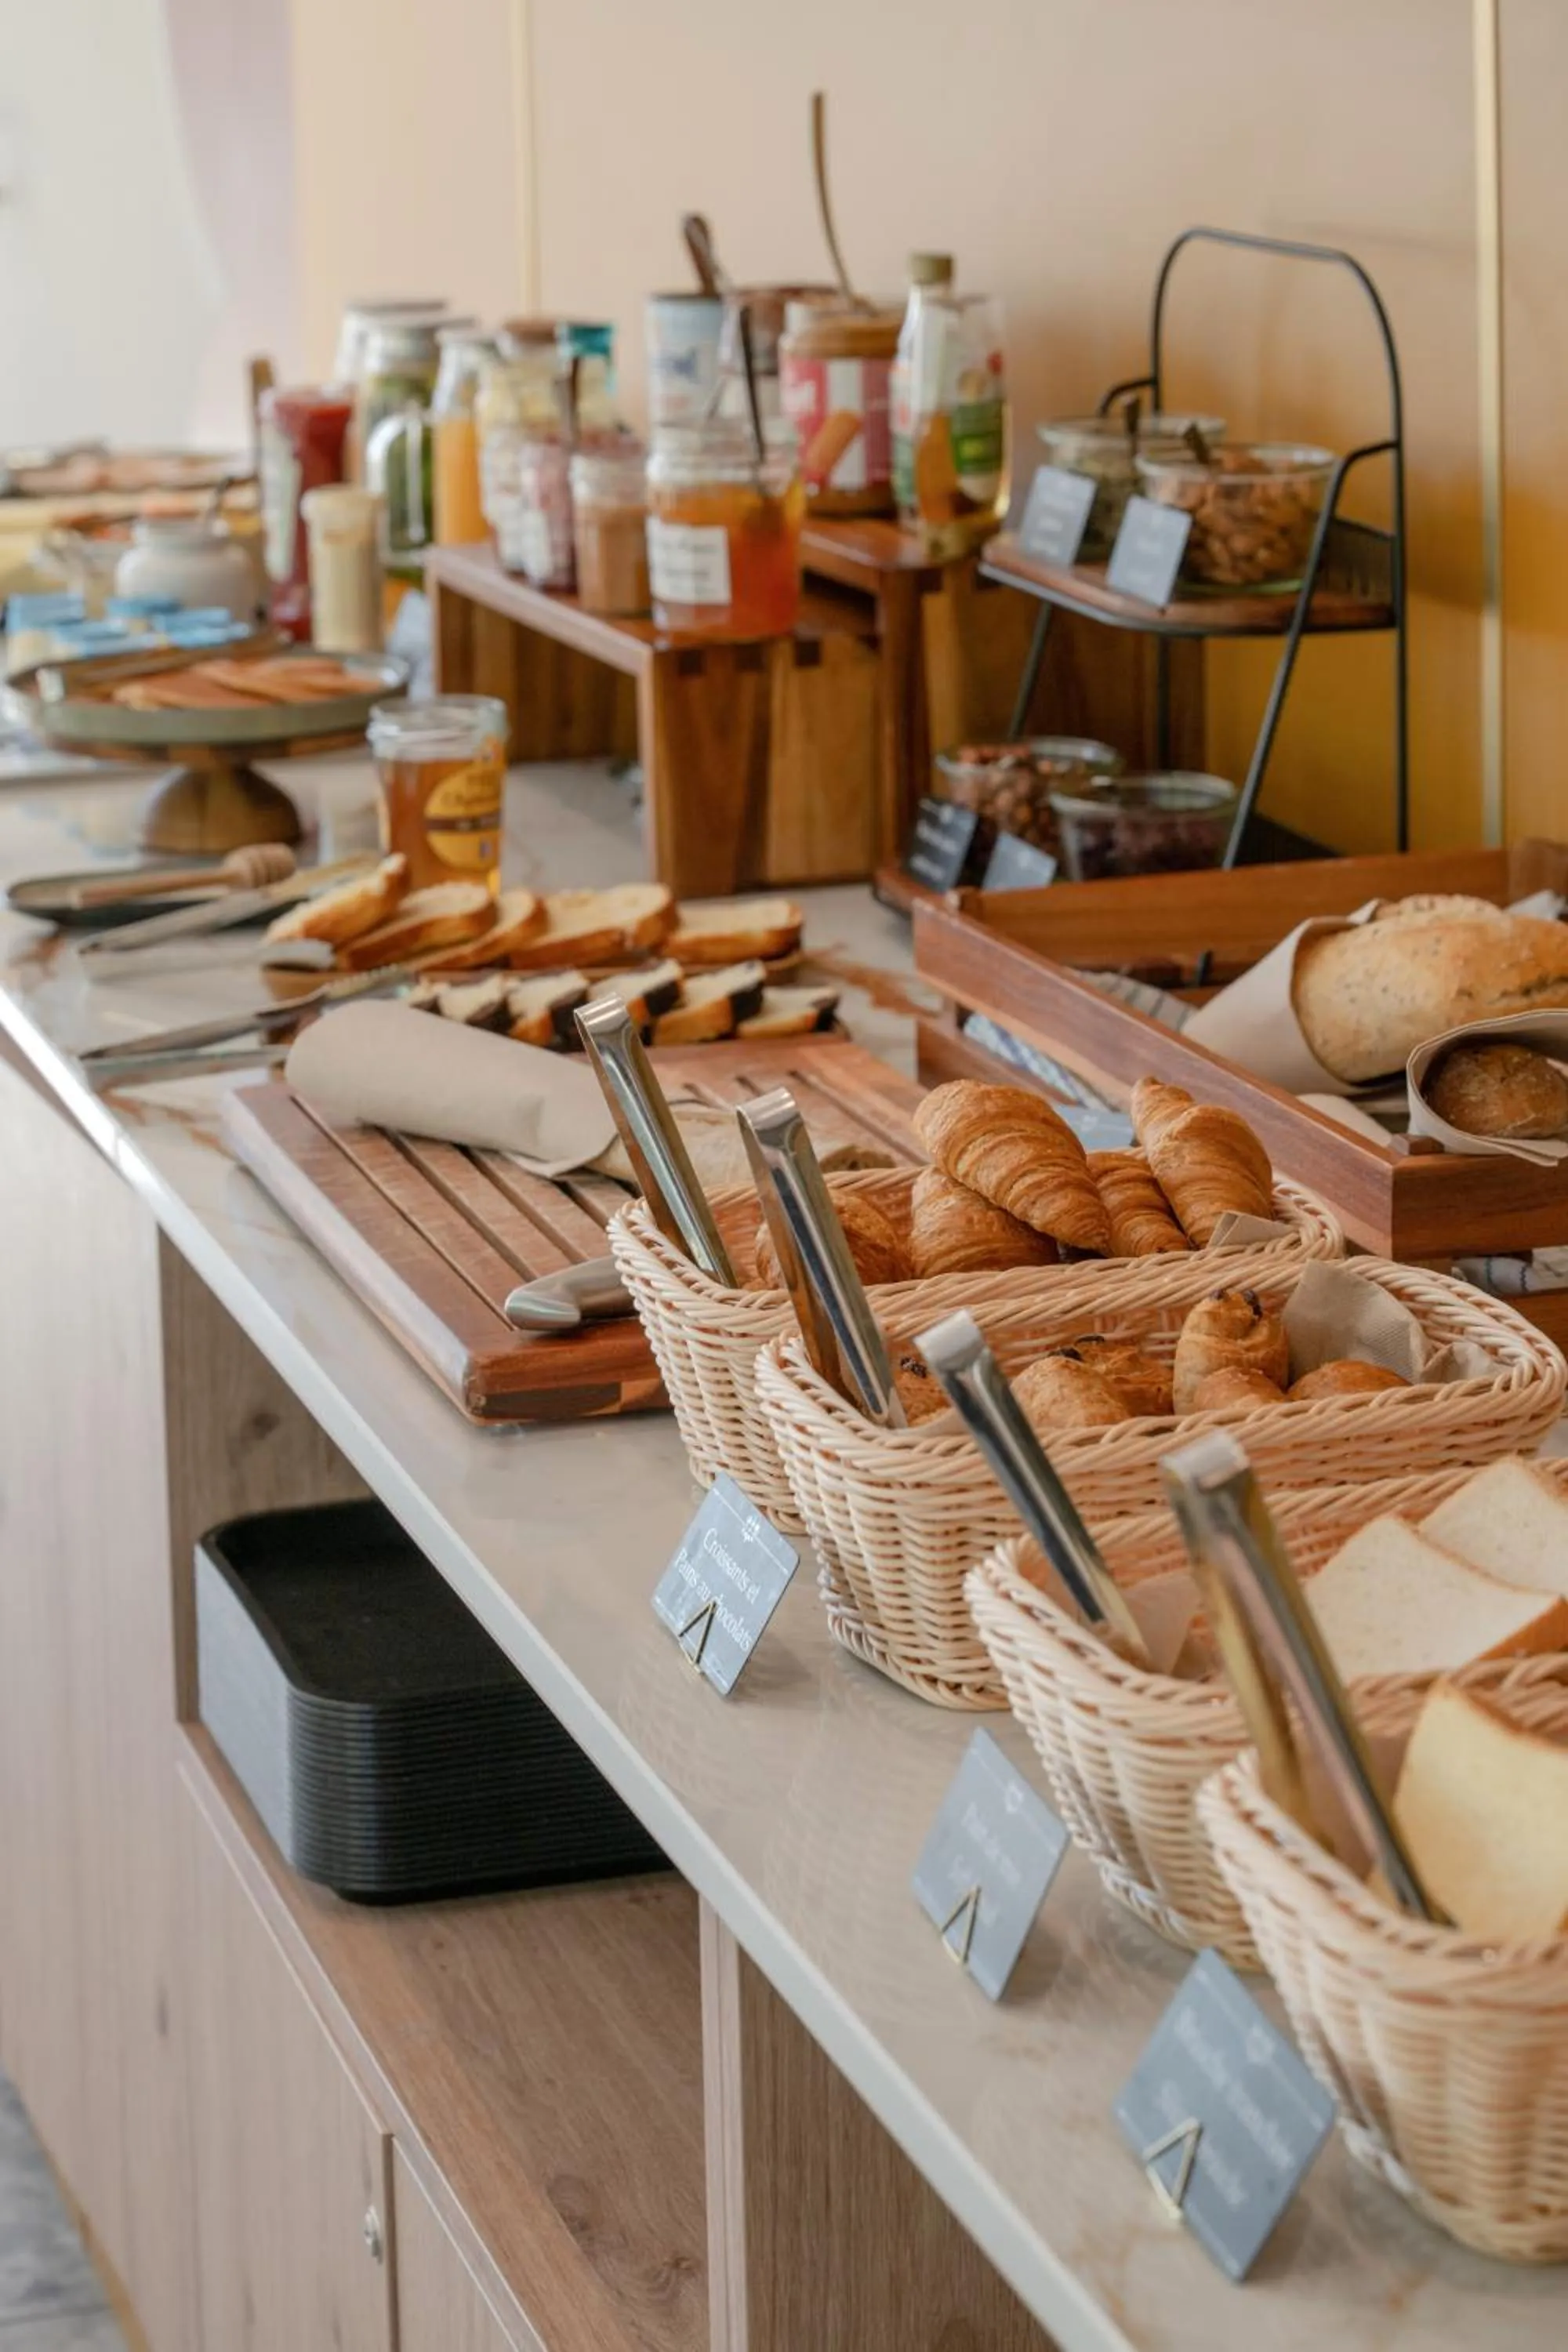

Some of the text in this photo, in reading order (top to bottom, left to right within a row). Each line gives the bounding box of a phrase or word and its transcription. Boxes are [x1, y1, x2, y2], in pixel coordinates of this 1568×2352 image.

[674, 1548, 697, 1588] Pains
[696, 1581, 711, 1602] au
[704, 1528, 761, 1605] Croissants et
